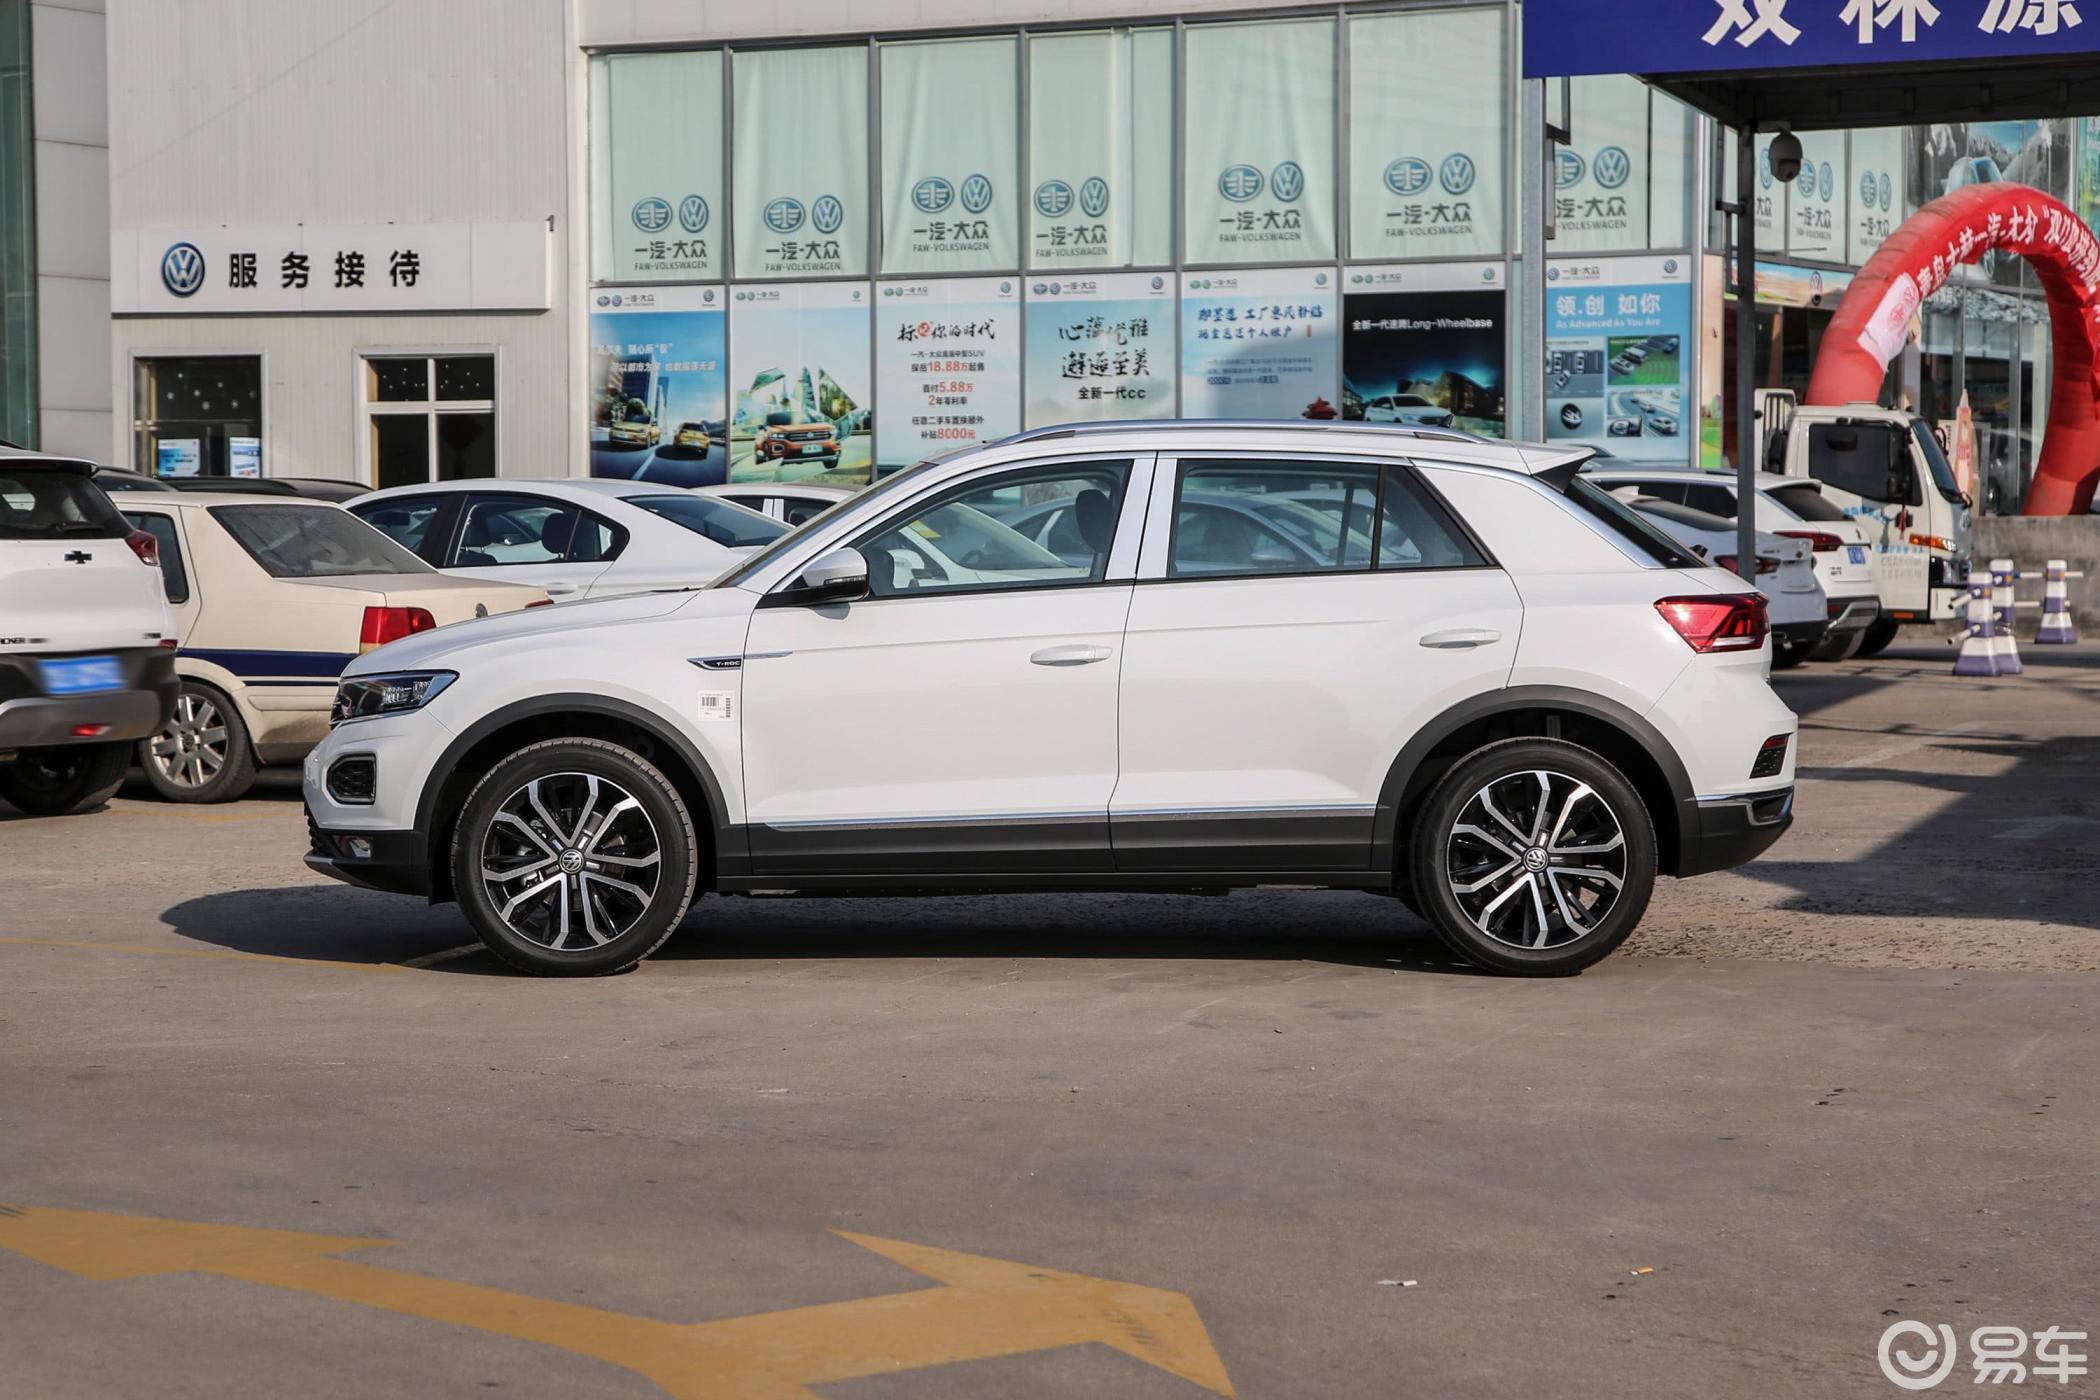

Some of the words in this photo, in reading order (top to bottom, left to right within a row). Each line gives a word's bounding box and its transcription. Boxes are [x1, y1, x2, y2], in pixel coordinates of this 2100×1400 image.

[1556, 196, 1627, 218] 汽-大众
[229, 250, 421, 288] 服务接待
[1618, 293, 1661, 314] 如你
